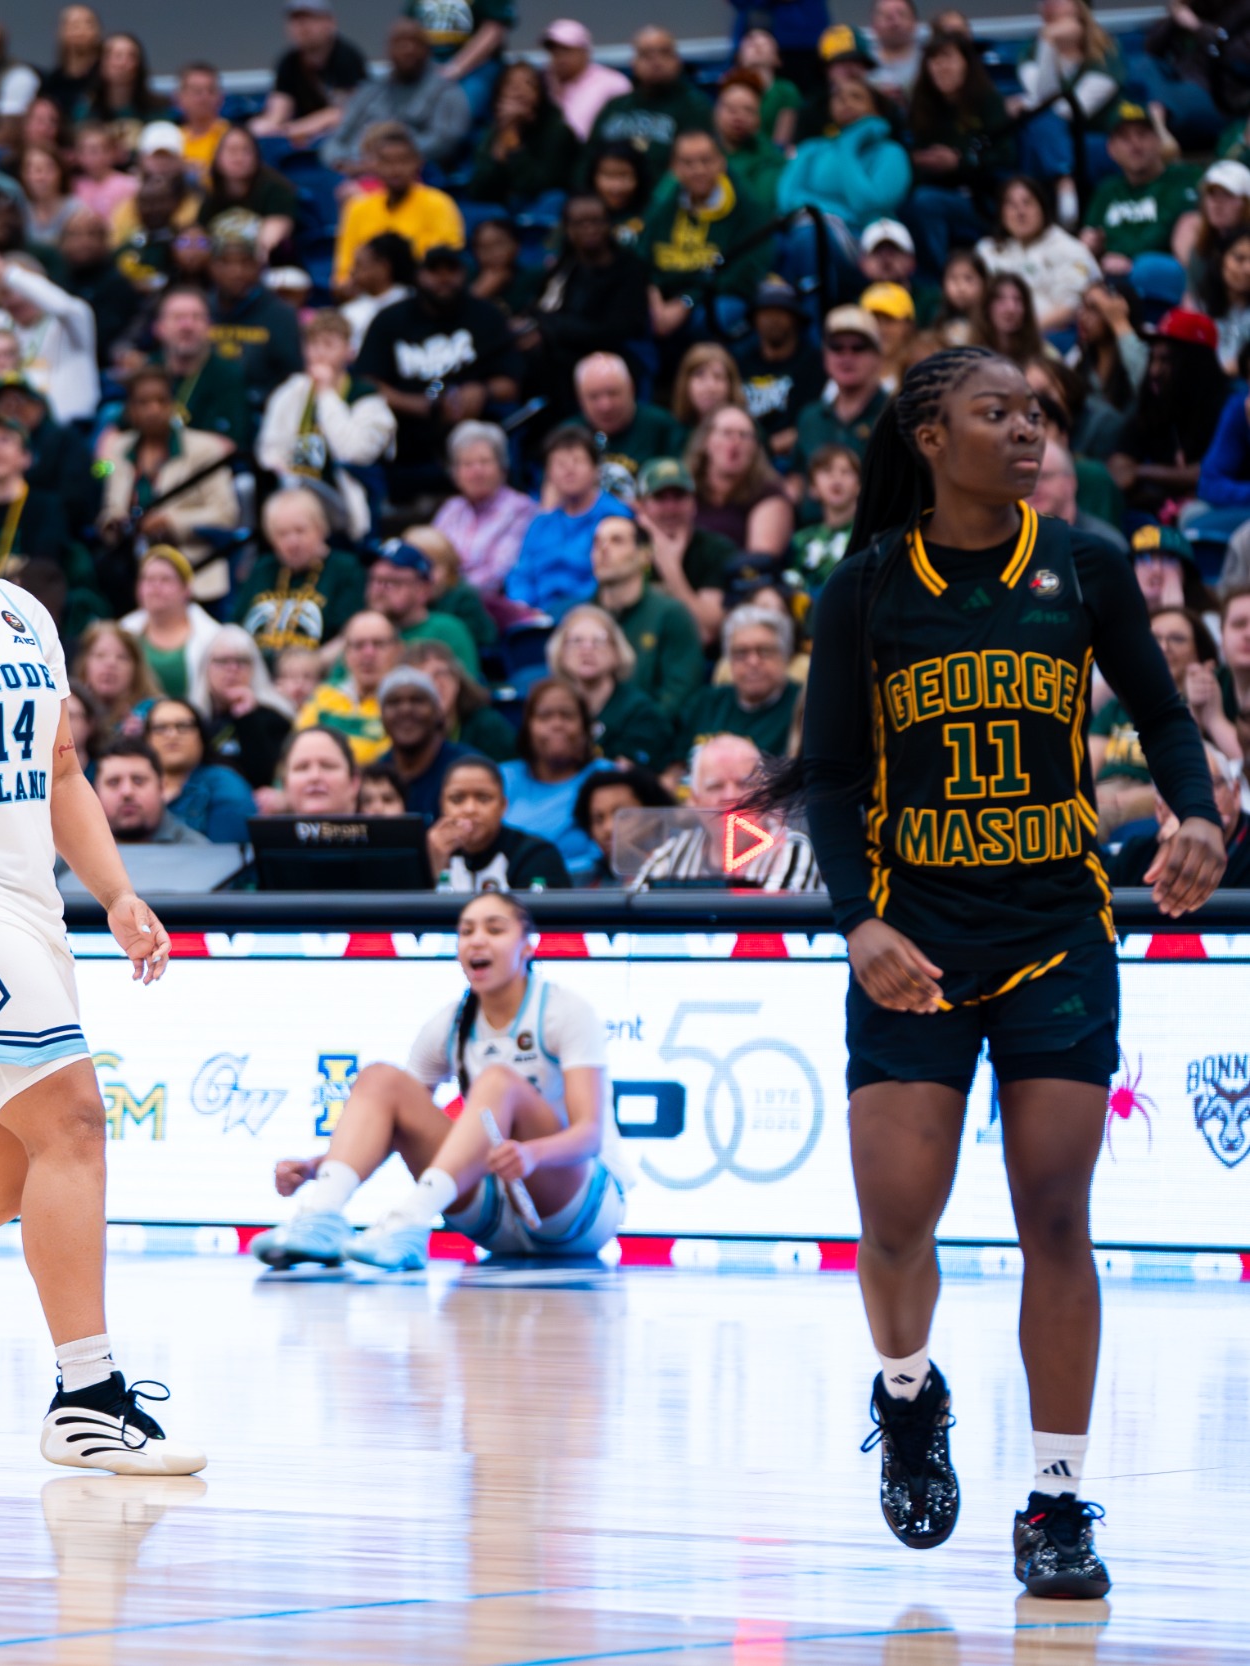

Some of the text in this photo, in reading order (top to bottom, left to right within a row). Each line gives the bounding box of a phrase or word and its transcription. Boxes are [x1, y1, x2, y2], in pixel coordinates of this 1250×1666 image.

[884, 649, 1078, 733] GEORGE
[942, 719, 1030, 800] 11
[896, 798, 1082, 867] MASON
